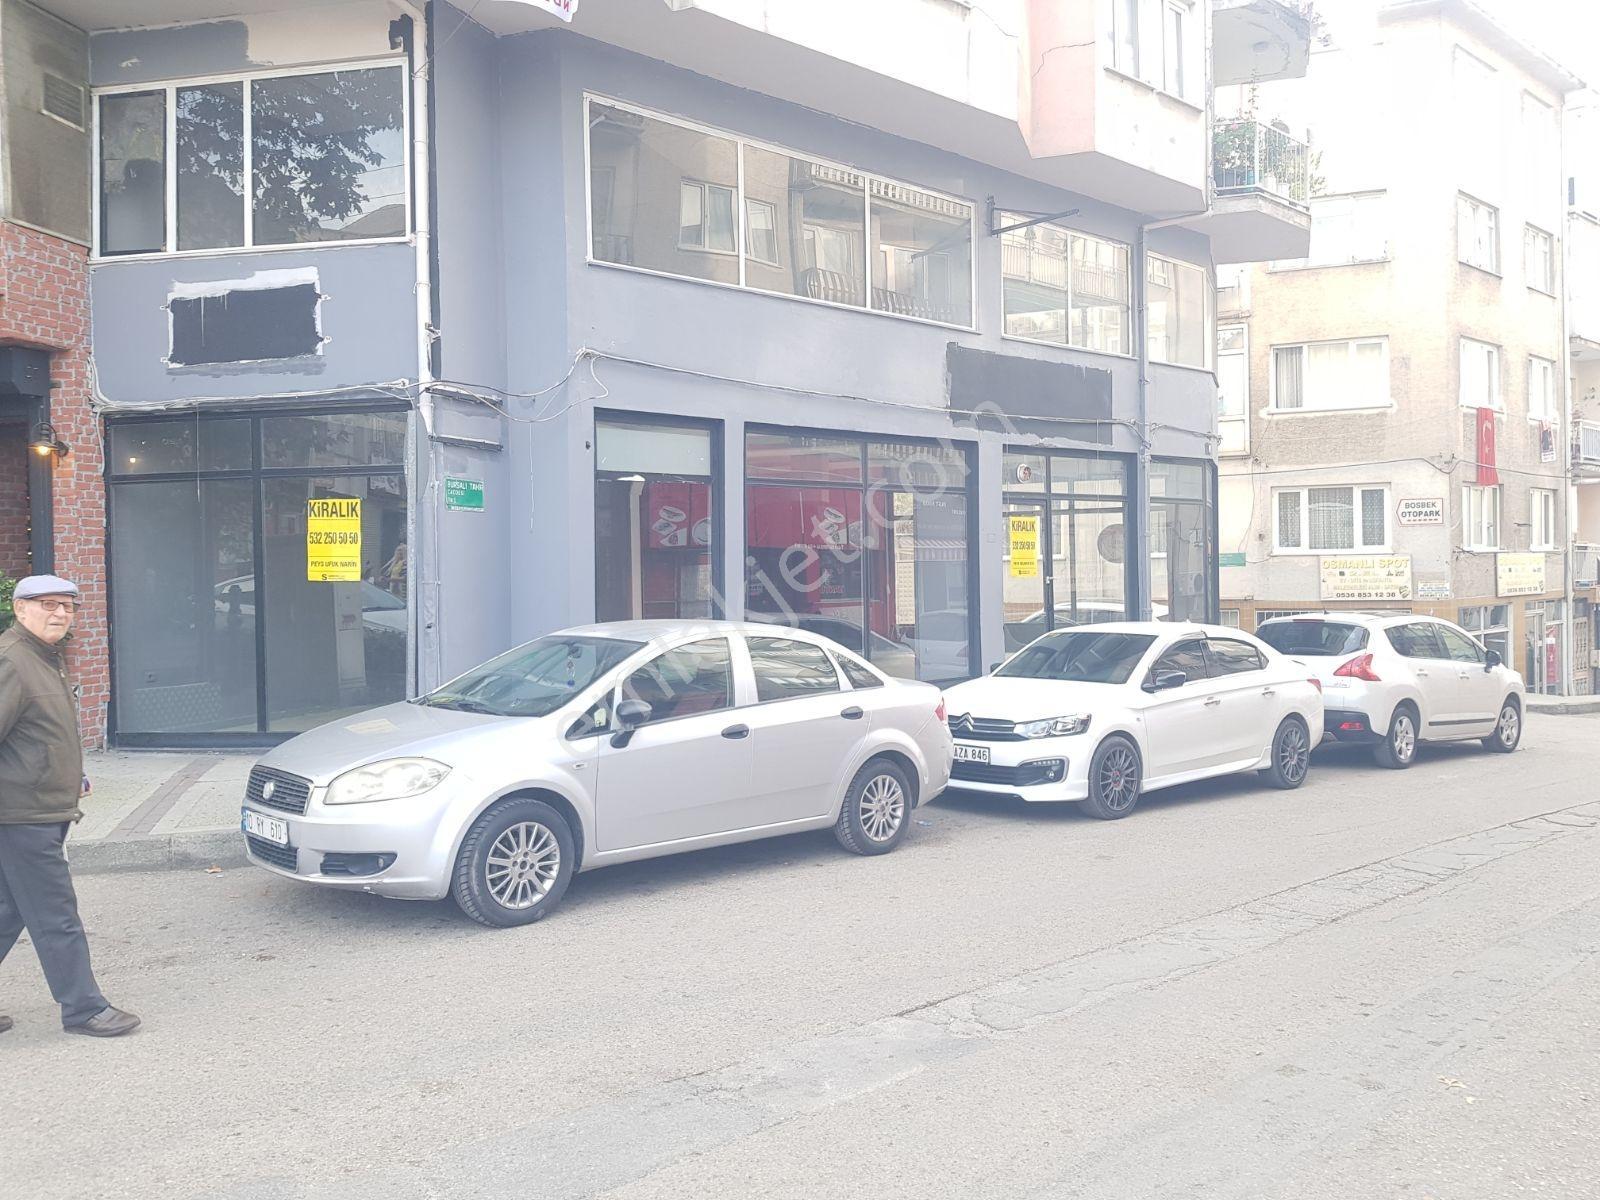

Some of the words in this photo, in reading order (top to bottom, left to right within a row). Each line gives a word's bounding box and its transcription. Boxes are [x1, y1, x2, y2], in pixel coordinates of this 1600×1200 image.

[310, 532, 322, 544] 532
[324, 532, 337, 544] 250
[338, 532, 348, 544] 50
[349, 532, 358, 544] 50
[1322, 560, 1375, 570] OSMANLI
[1379, 559, 1409, 569] SPOT
[954, 746, 968, 758] AZA
[972, 749, 987, 760] 846
